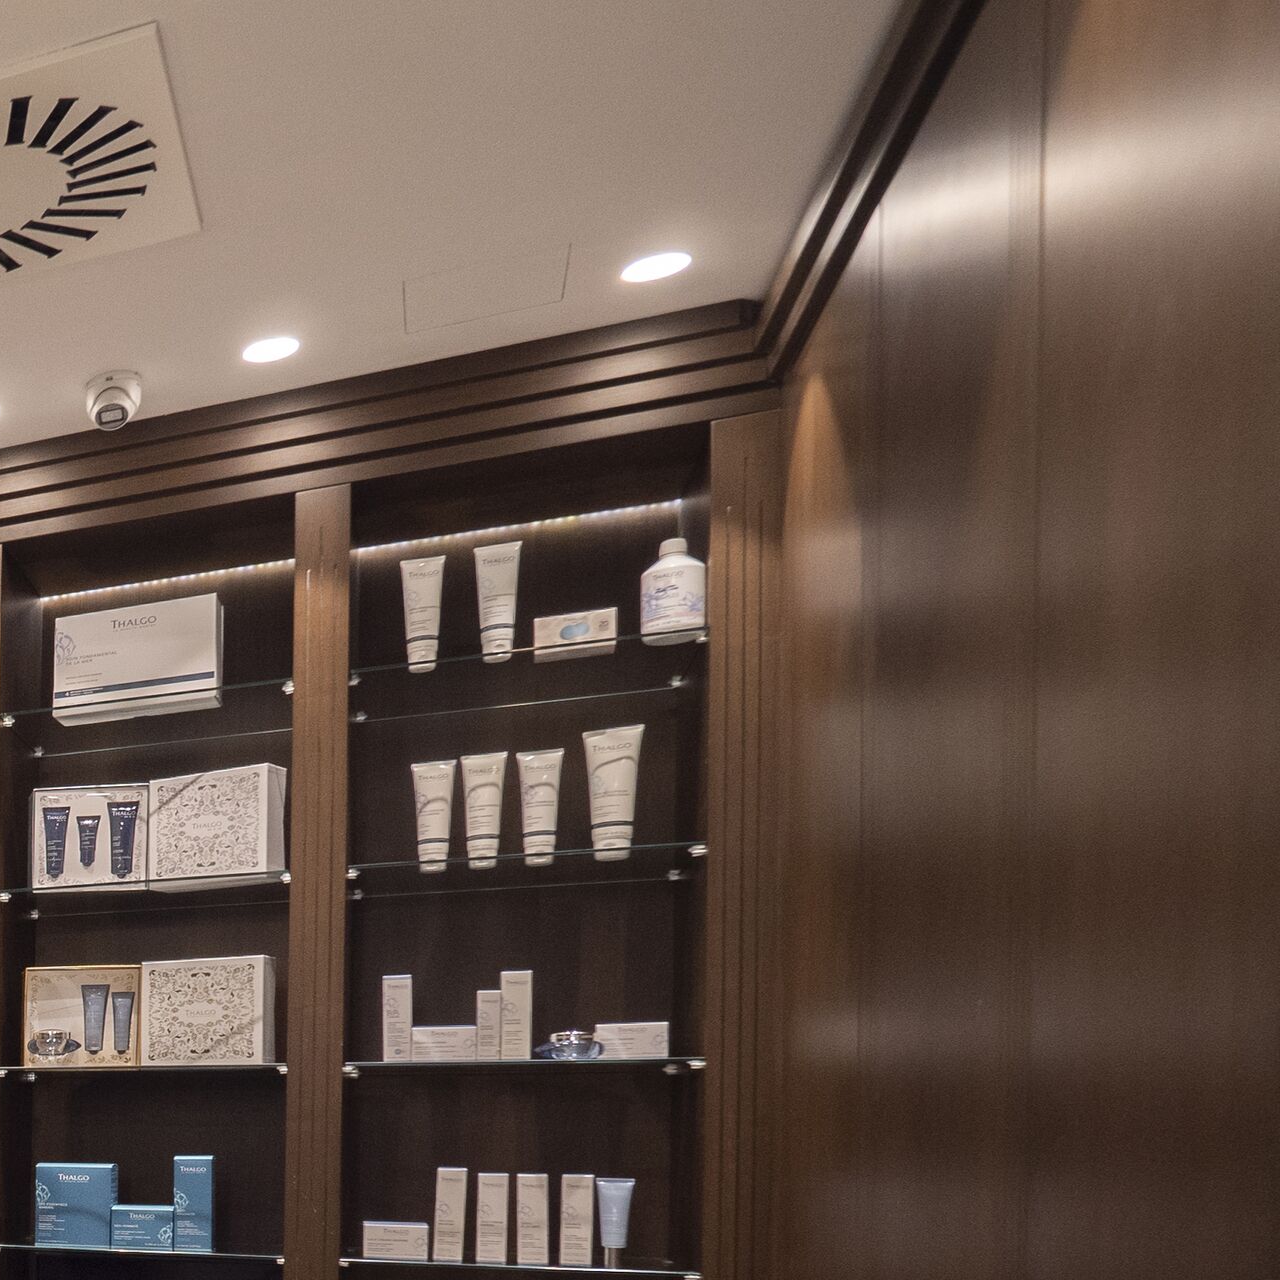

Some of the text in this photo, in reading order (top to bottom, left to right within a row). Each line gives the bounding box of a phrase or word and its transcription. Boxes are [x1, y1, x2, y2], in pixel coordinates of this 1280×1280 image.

[111, 615, 157, 629] THALGO
[592, 743, 632, 753] THALGO
[58, 1173, 90, 1181] THALGO
